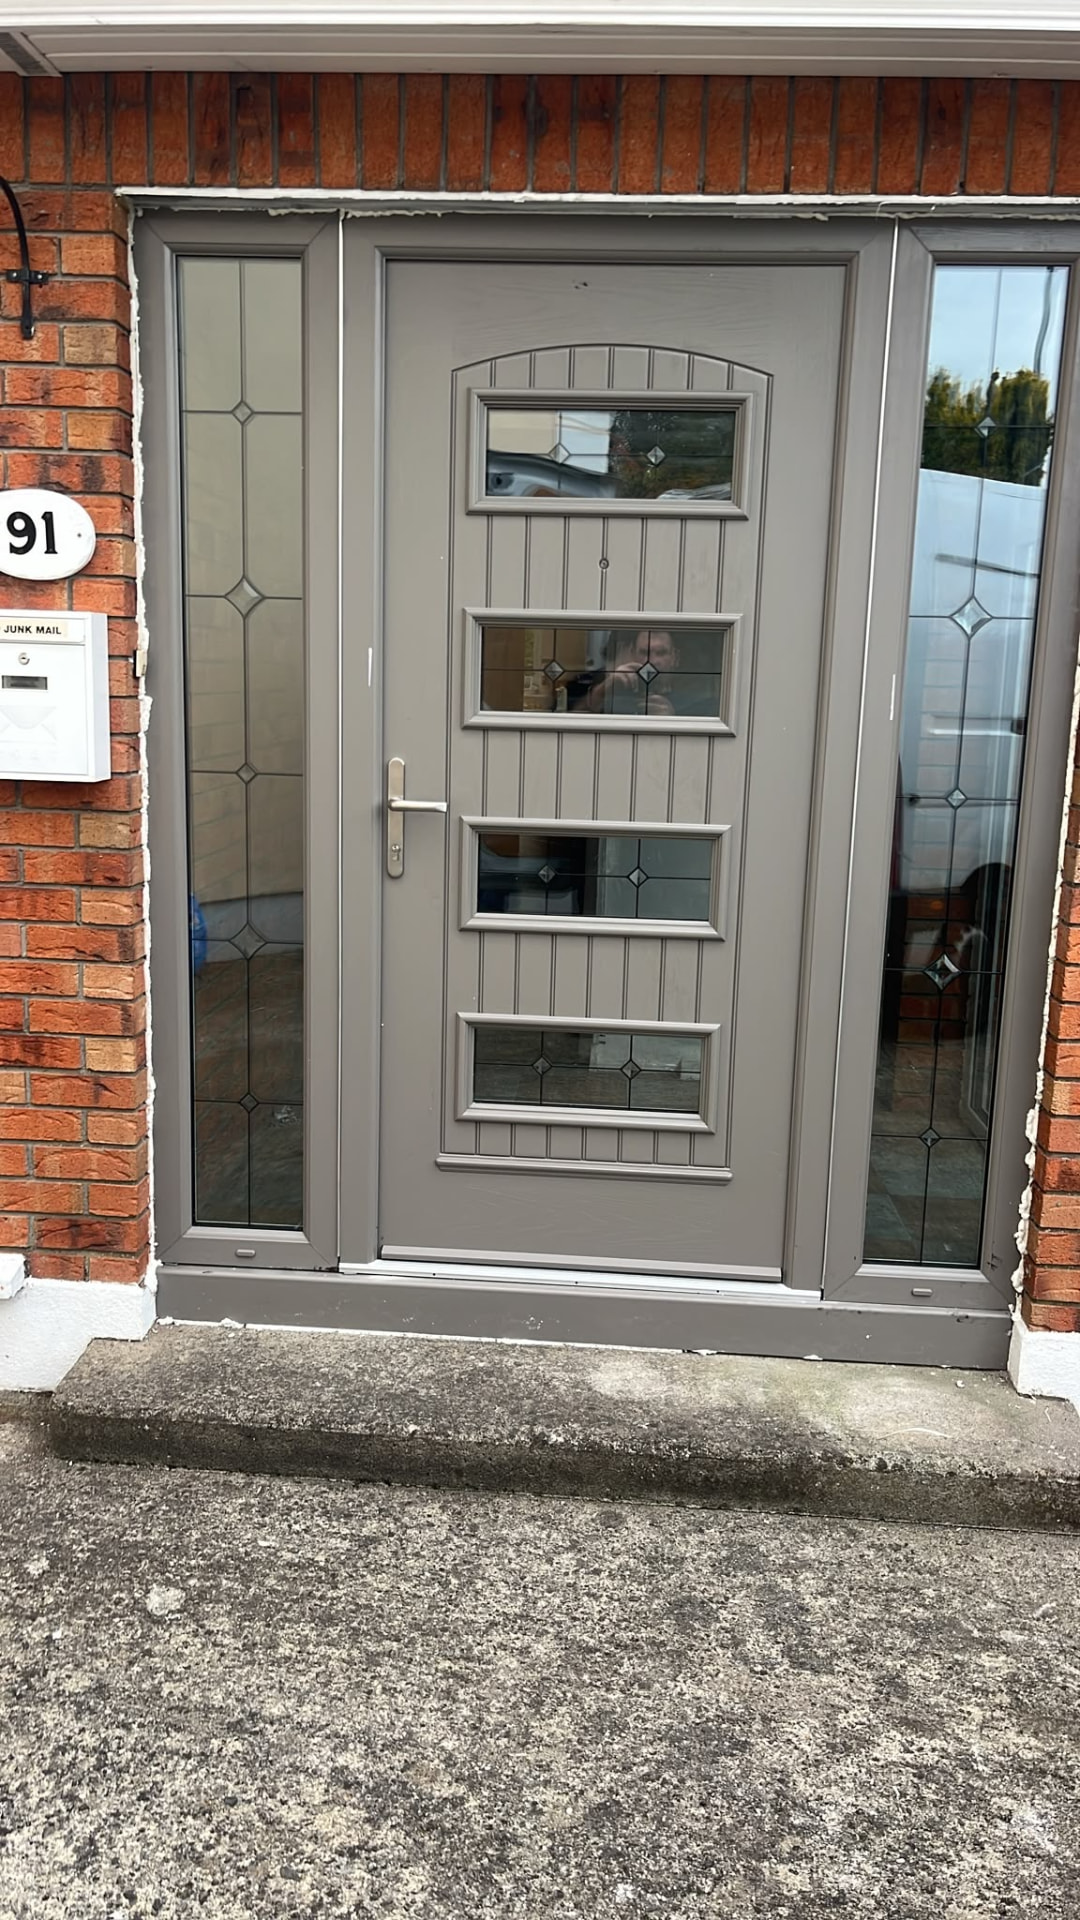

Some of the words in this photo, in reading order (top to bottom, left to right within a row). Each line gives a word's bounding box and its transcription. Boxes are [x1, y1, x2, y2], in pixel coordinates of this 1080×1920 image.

[6, 511, 58, 555] 91
[3, 625, 32, 634] JUNK
[36, 626, 62, 635] MAIL
